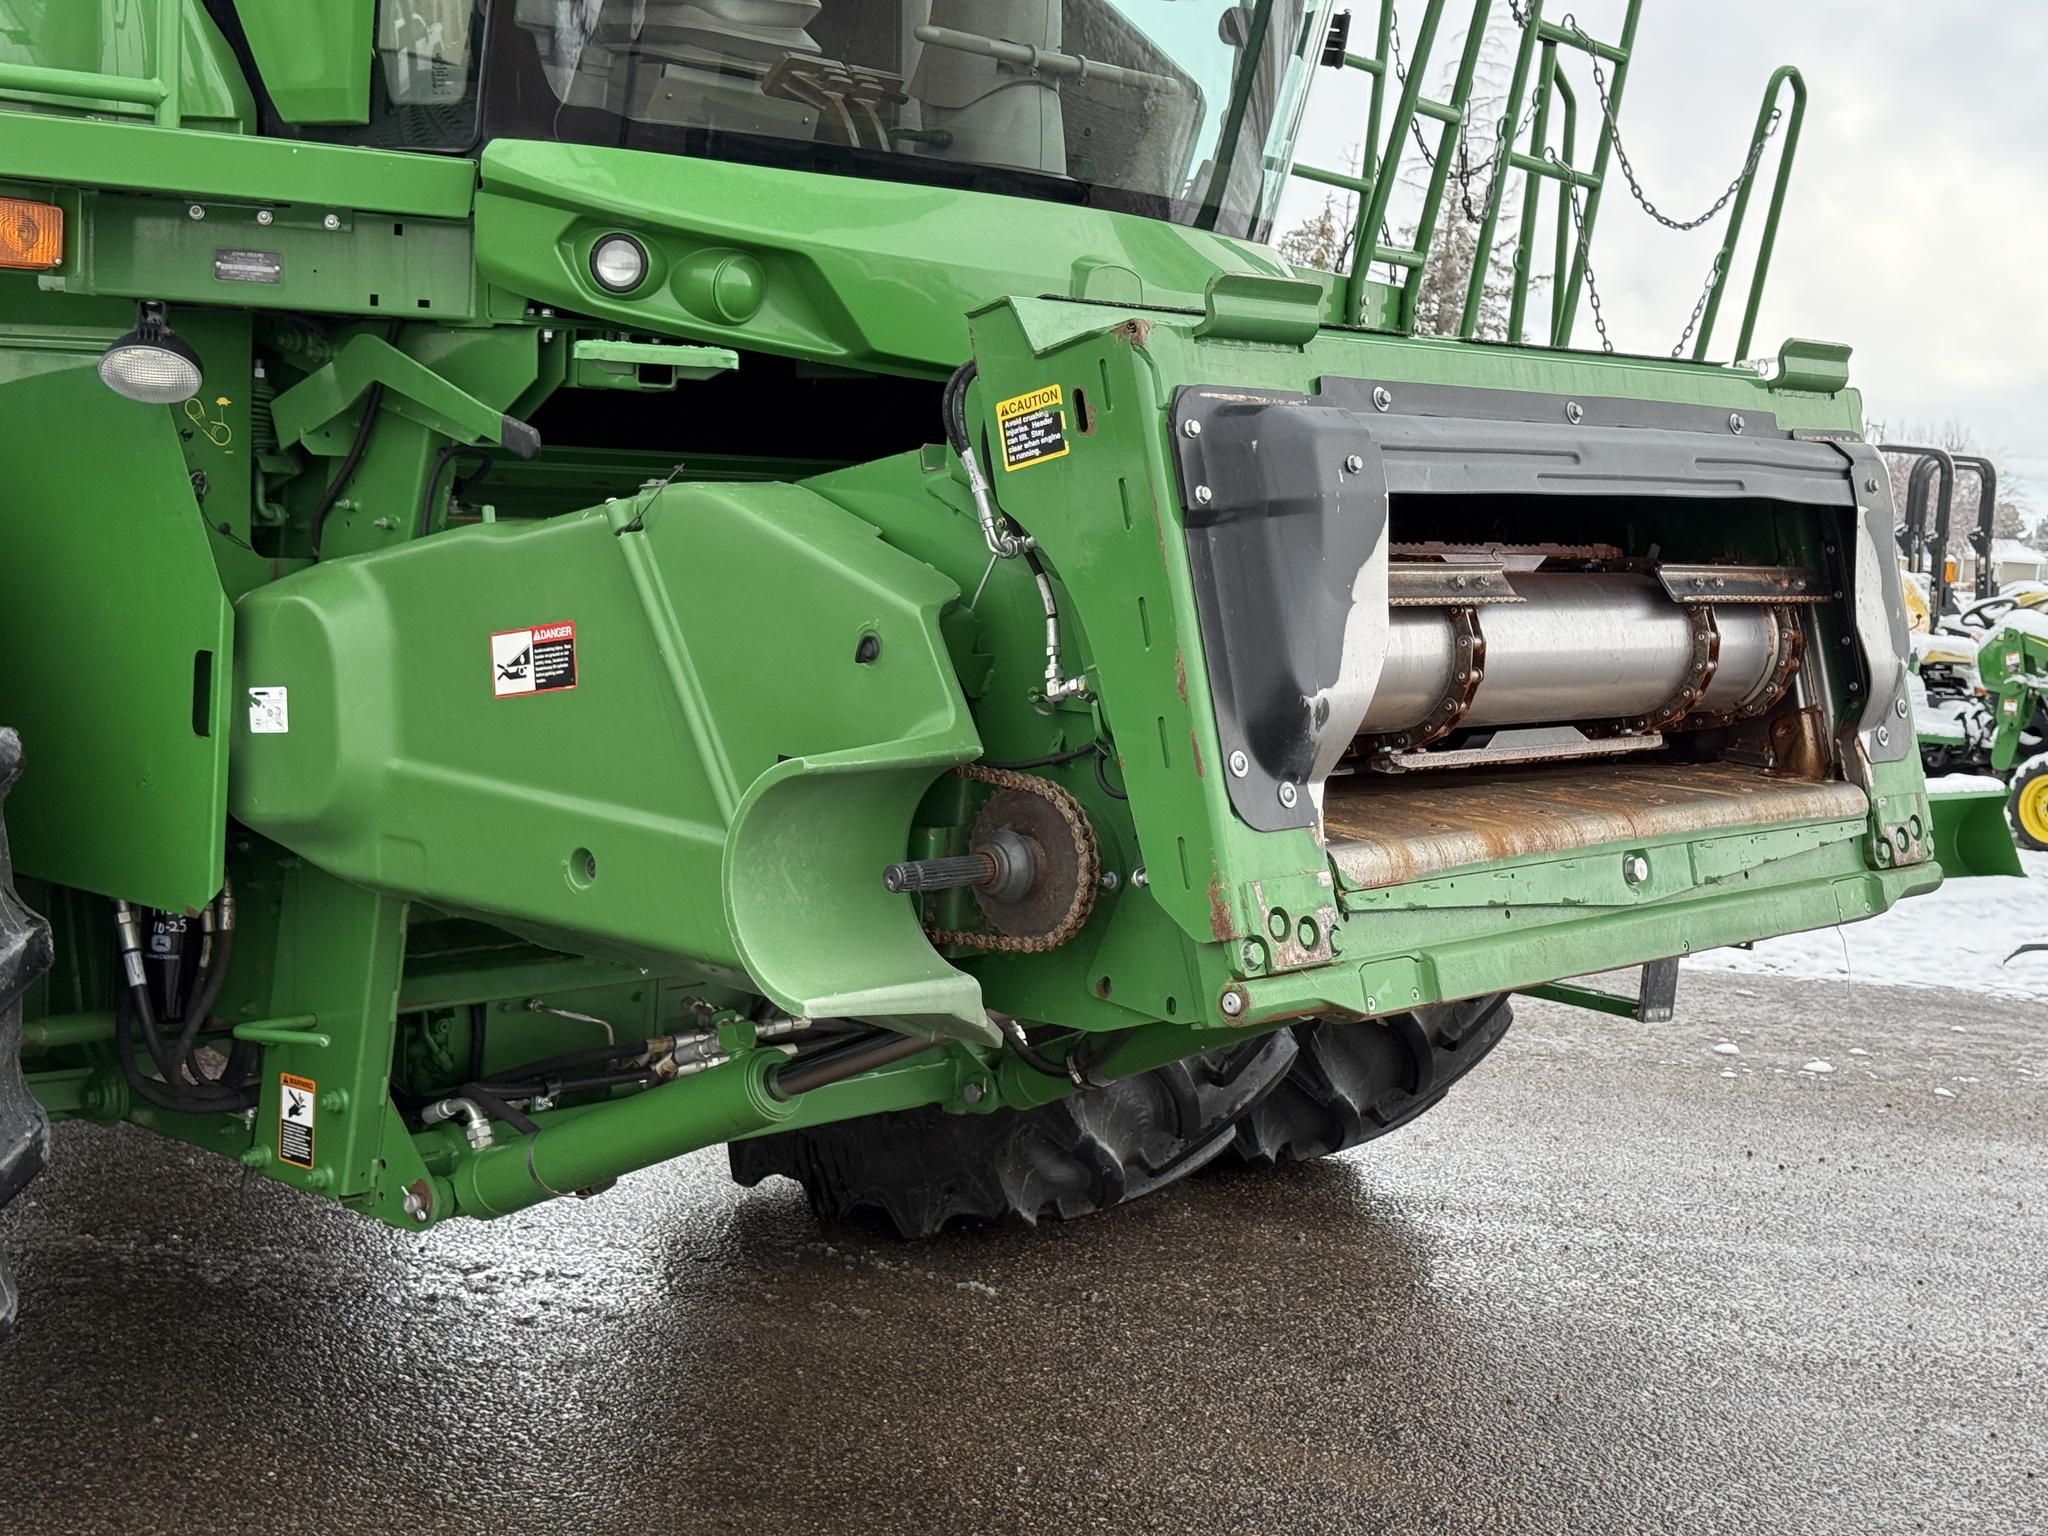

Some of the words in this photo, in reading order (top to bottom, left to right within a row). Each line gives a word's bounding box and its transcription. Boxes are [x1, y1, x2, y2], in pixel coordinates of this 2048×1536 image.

[1008, 388, 1058, 413] CAUTION
[1004, 416, 1022, 429] Avoid
[1022, 410, 1049, 423] crushing
[1006, 425, 1029, 438] injuries.
[1031, 417, 1053, 429] Header
[1007, 437, 1018, 445] can
[1031, 429, 1044, 438] Stay
[1008, 444, 1023, 454] clear
[1023, 439, 1040, 449] when
[1040, 433, 1061, 444] engine
[1009, 454, 1015, 462] is
[1016, 448, 1041, 460] running.
[540, 625, 572, 639] DANGER
[153, 918, 187, 934] 10-25
[289, 1077, 313, 1090] WARNING
